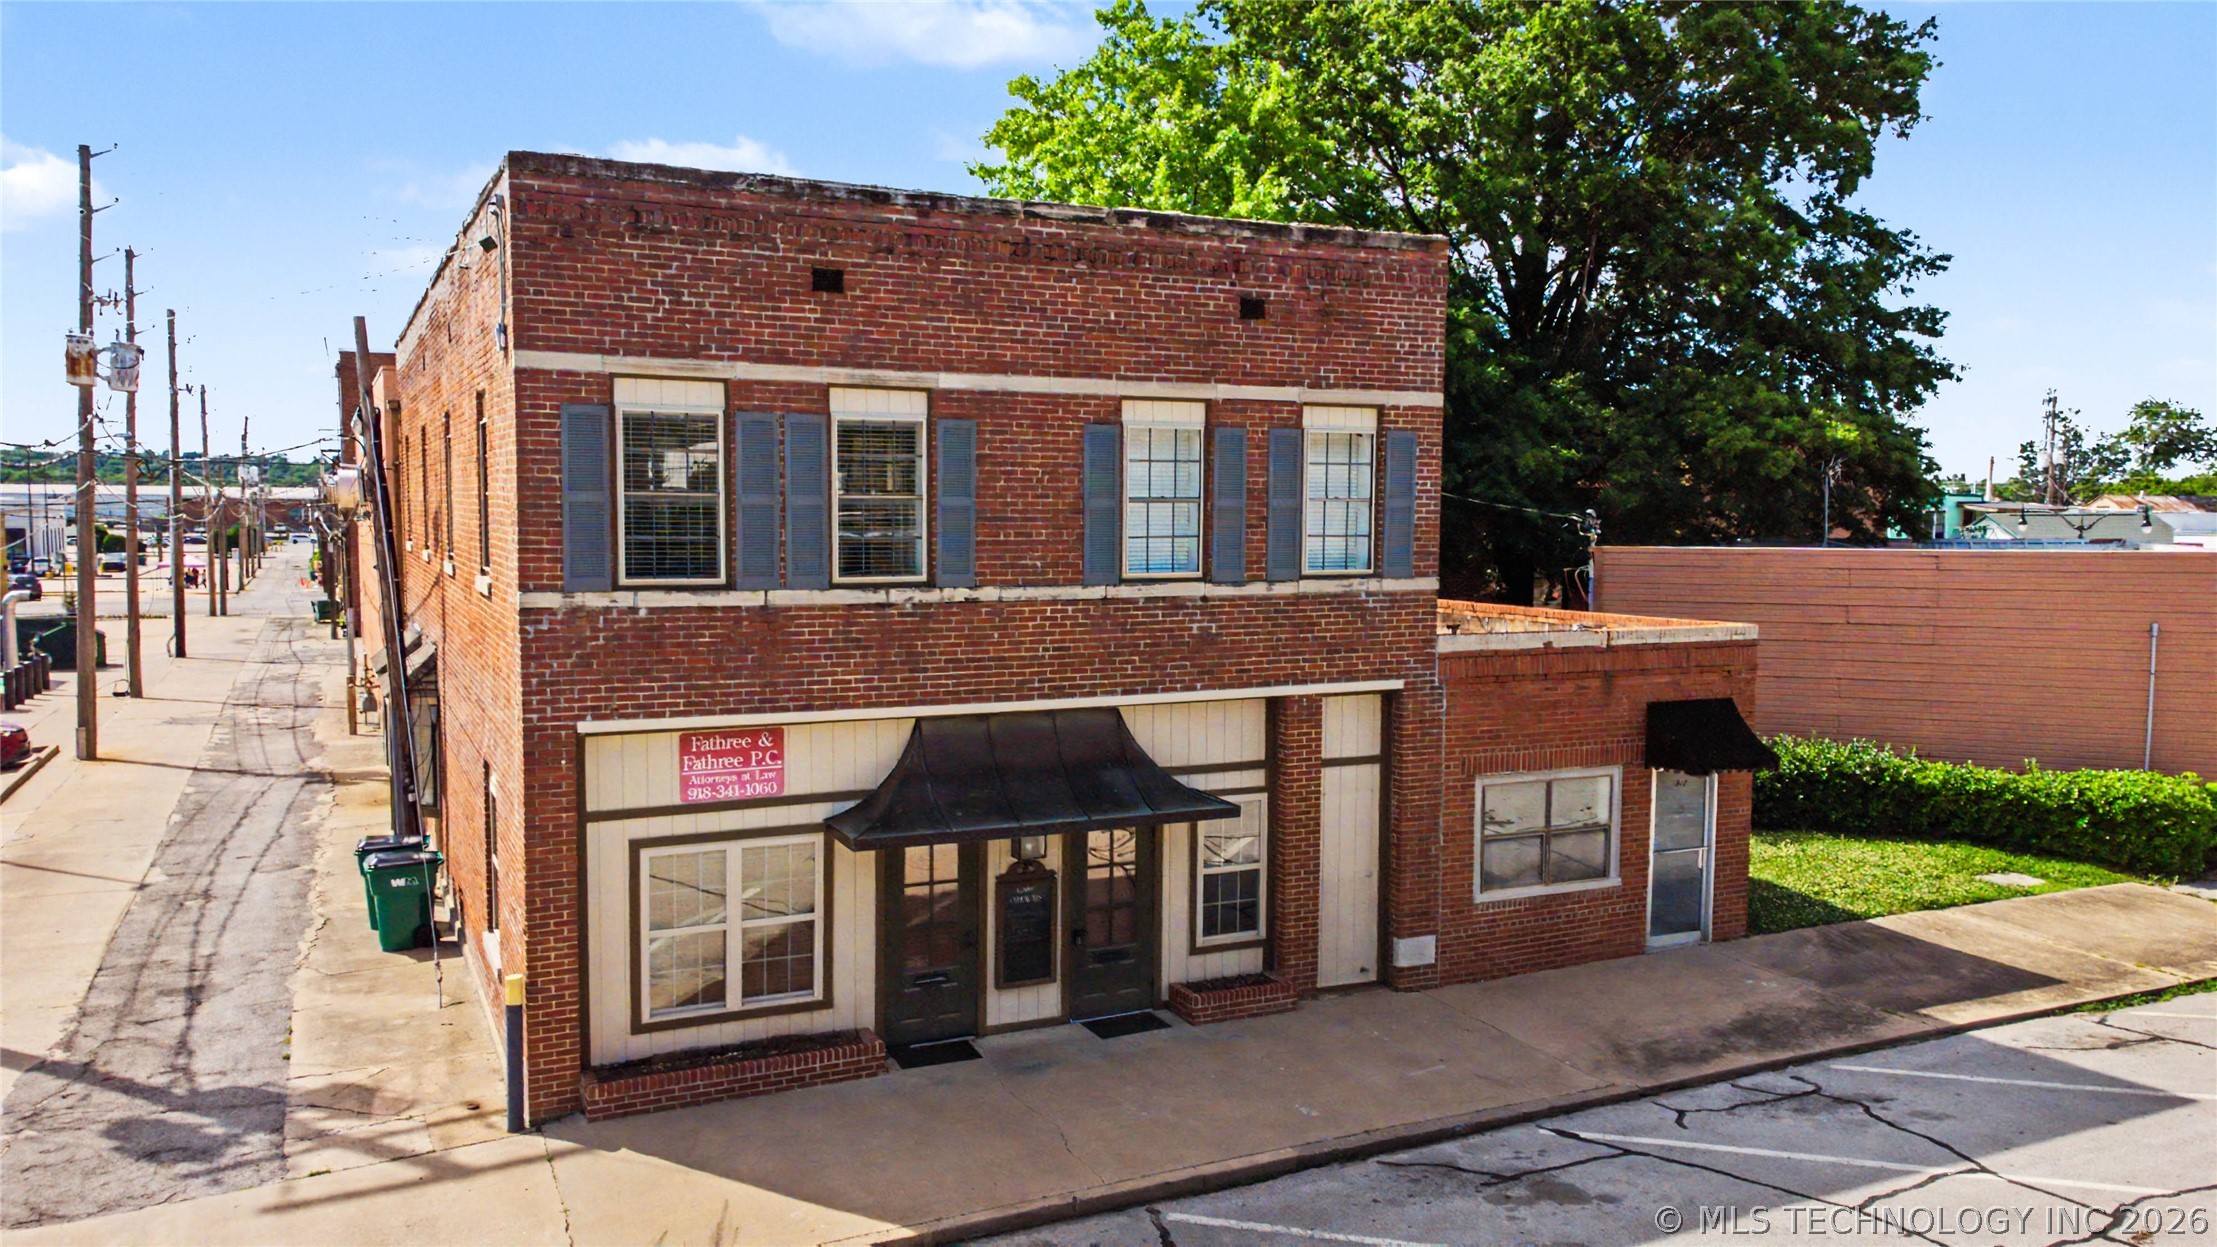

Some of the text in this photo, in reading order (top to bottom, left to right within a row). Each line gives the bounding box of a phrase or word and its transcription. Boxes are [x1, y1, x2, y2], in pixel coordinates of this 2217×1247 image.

[691, 731, 774, 752] Fathree &
[683, 750, 782, 771] Fathree P.C.
[689, 770, 777, 785] Attorneys at Law
[687, 781, 777, 800] 918-341-1060
